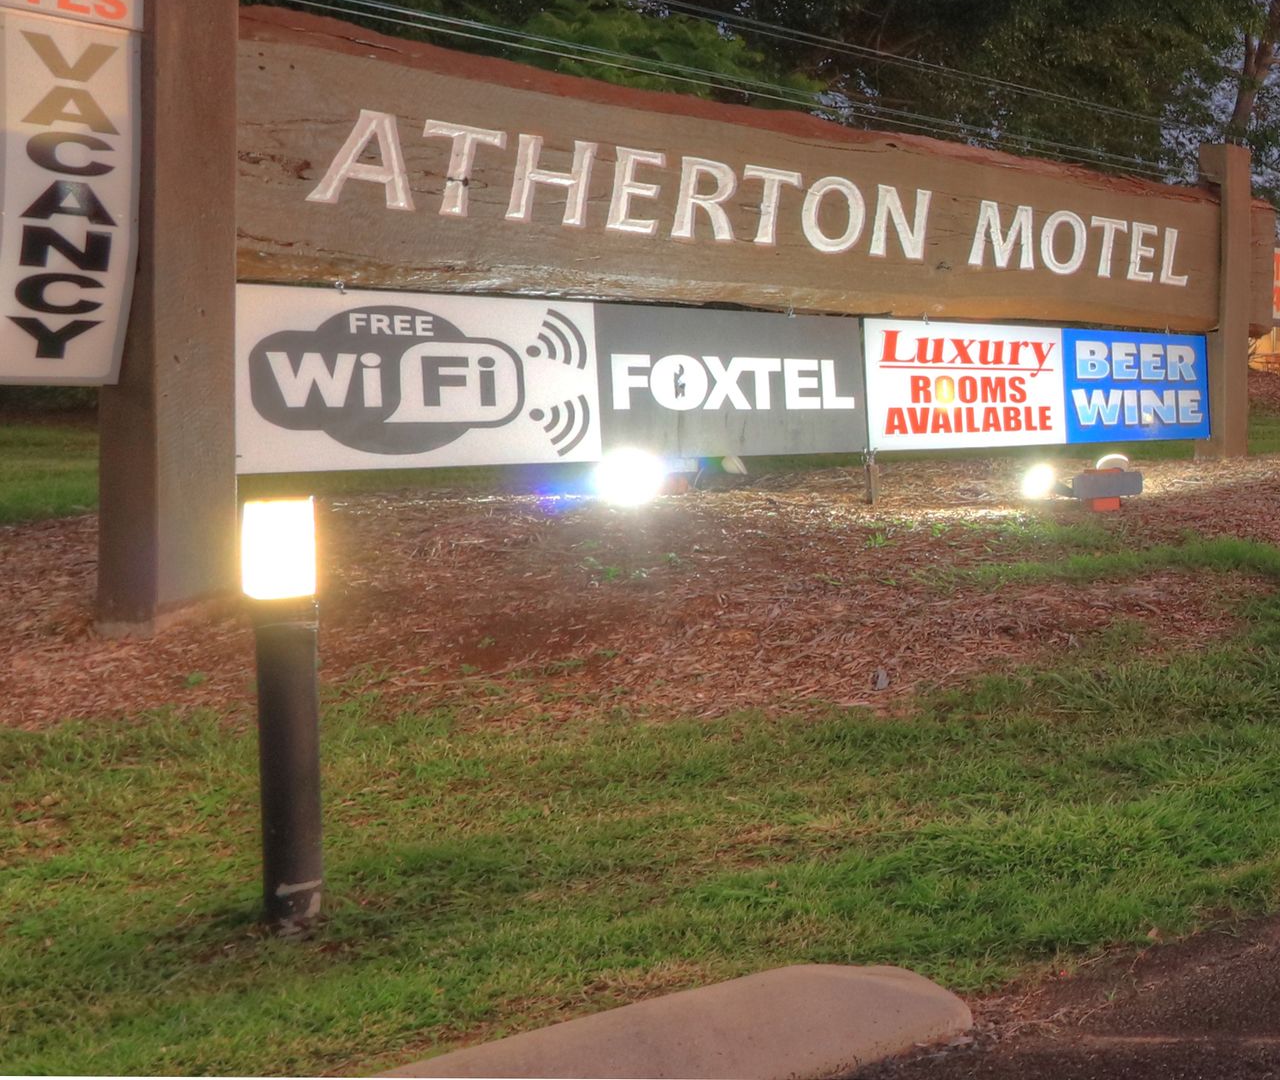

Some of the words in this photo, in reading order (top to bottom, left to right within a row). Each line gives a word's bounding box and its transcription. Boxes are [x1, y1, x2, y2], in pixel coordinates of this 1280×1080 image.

[5, 29, 121, 360] VACANCY
[305, 108, 932, 262] ATHERTON
[967, 198, 1190, 288] MOTEL
[348, 312, 434, 337] FREE
[879, 329, 1055, 377] Luxury
[1075, 340, 1197, 382] BEER
[610, 353, 855, 412] FOXTEL
[910, 375, 1027, 404] ROOMS
[884, 405, 1053, 435] AVAILABLE
[1071, 389, 1204, 427] WINE
